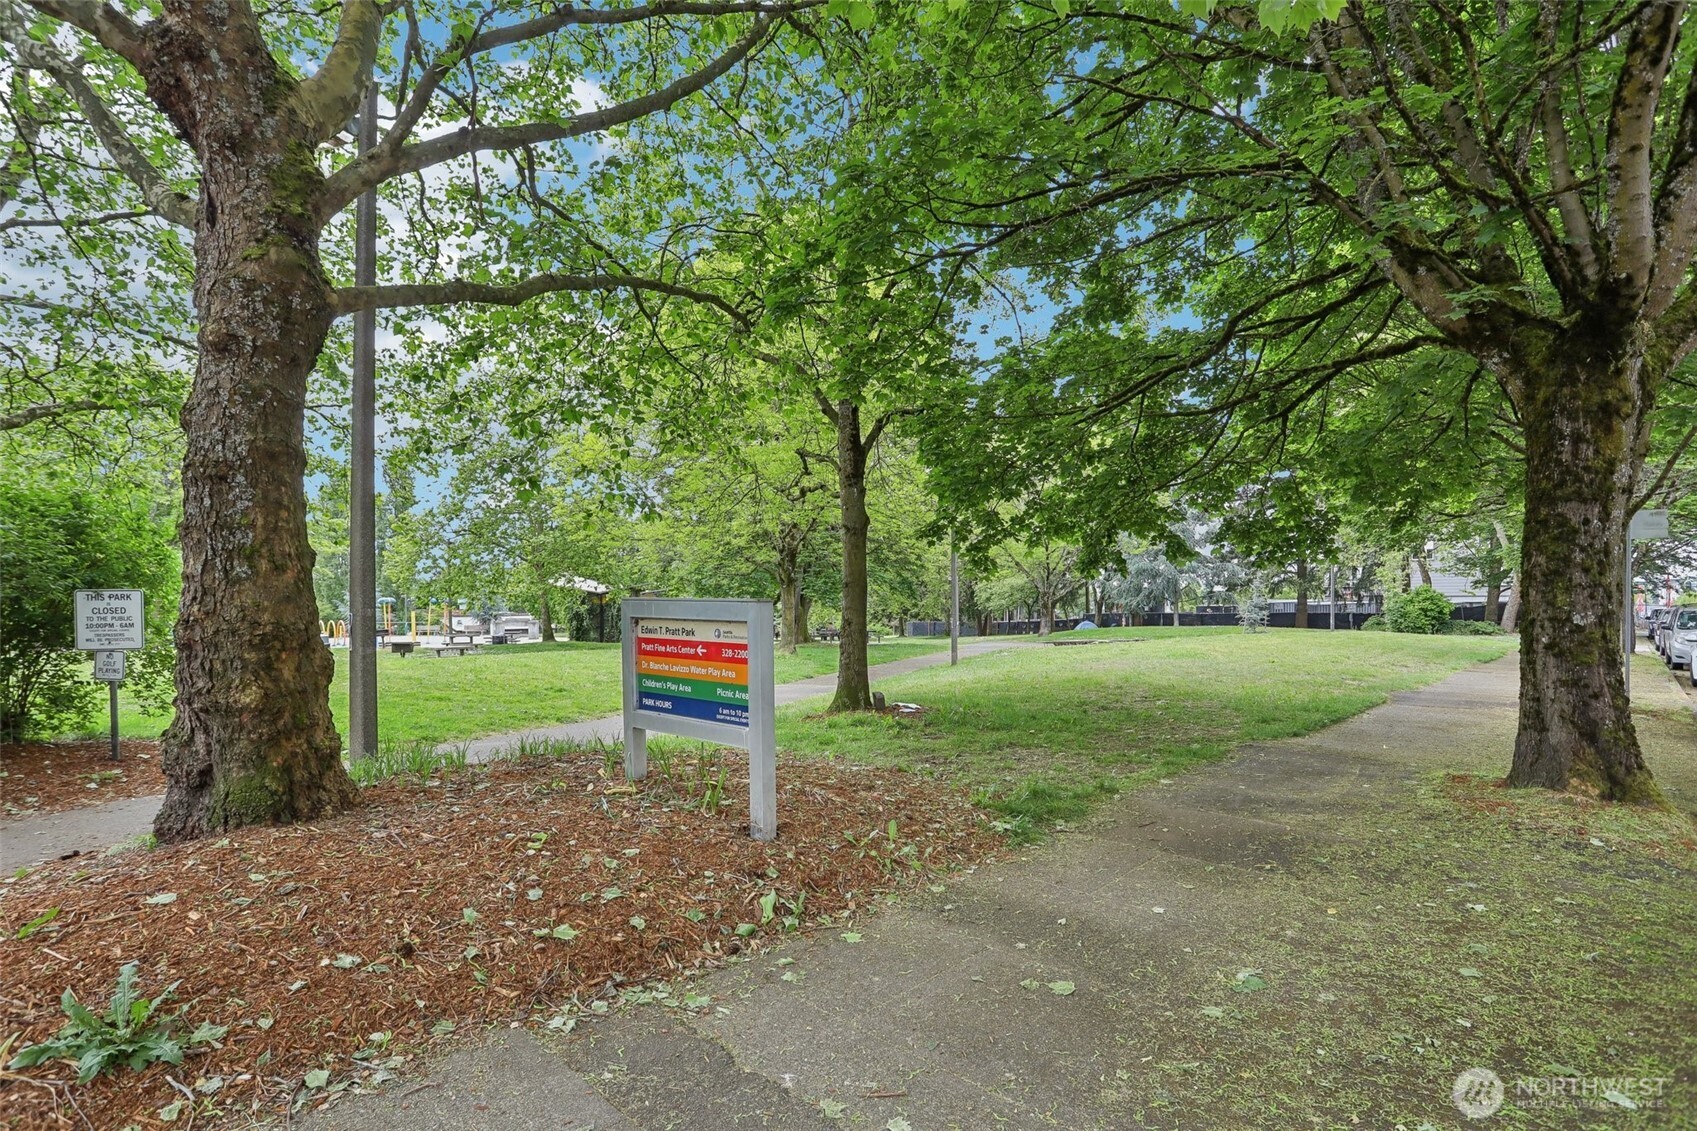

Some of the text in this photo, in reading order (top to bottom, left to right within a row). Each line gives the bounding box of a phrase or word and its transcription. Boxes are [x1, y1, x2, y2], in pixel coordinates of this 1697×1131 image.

[85, 593, 132, 601] THIS PARK
[91, 606, 127, 615] CLOSED
[641, 625, 696, 637] Edwin T. Pratt Park
[641, 642, 654, 652] Pratt
[654, 643, 666, 653] Fine
[666, 644, 677, 654] Arts
[678, 645, 696, 655] Center
[98, 667, 121, 675] PLAYING
[641, 660, 736, 679] Dr. Blanche Lavizzo Water Play Area
[642, 678, 749, 700] Children's Play Area Picnic Area
[642, 697, 655, 706] PARK
[655, 699, 673, 709] HOURS
[736, 709, 742, 717] 10
